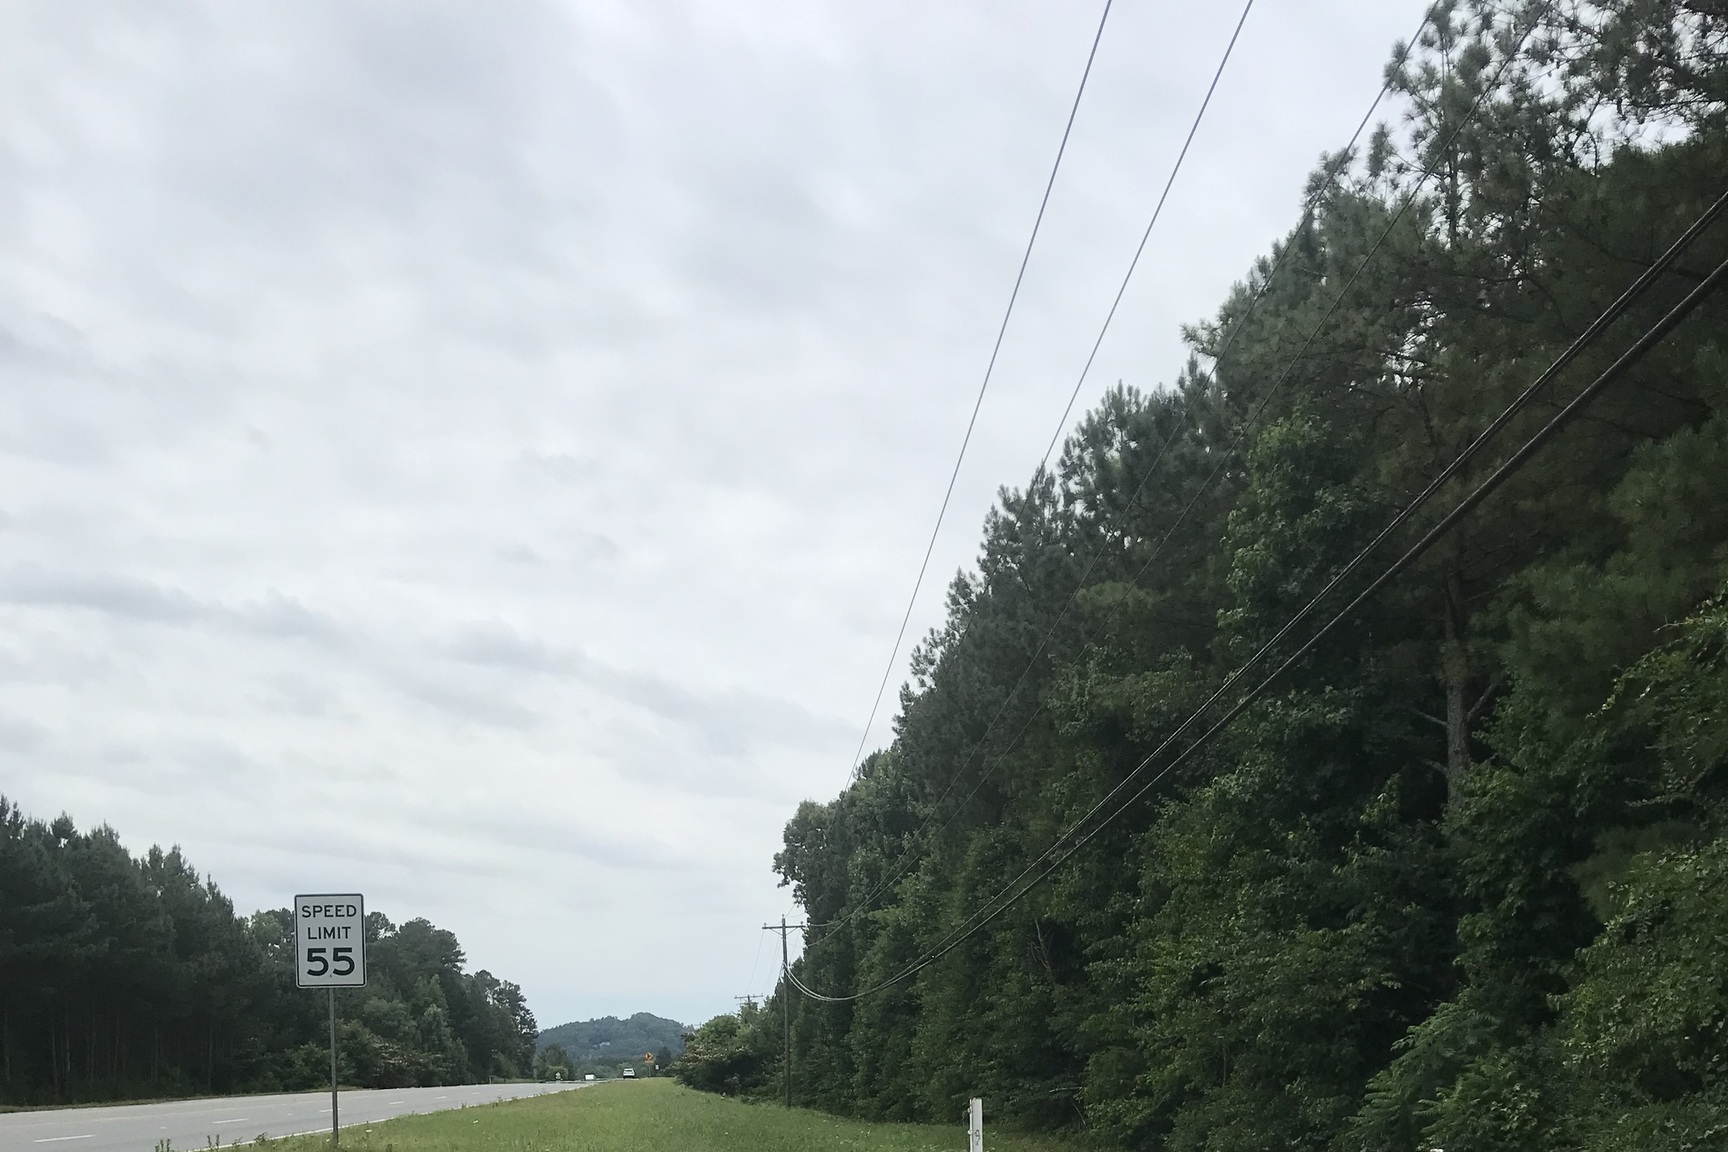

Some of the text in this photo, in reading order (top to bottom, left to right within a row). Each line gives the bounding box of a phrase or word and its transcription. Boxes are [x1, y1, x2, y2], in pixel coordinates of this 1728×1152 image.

[302, 905, 357, 918] SPEED
[308, 926, 351, 940] LIMIT
[307, 947, 355, 976] 55
